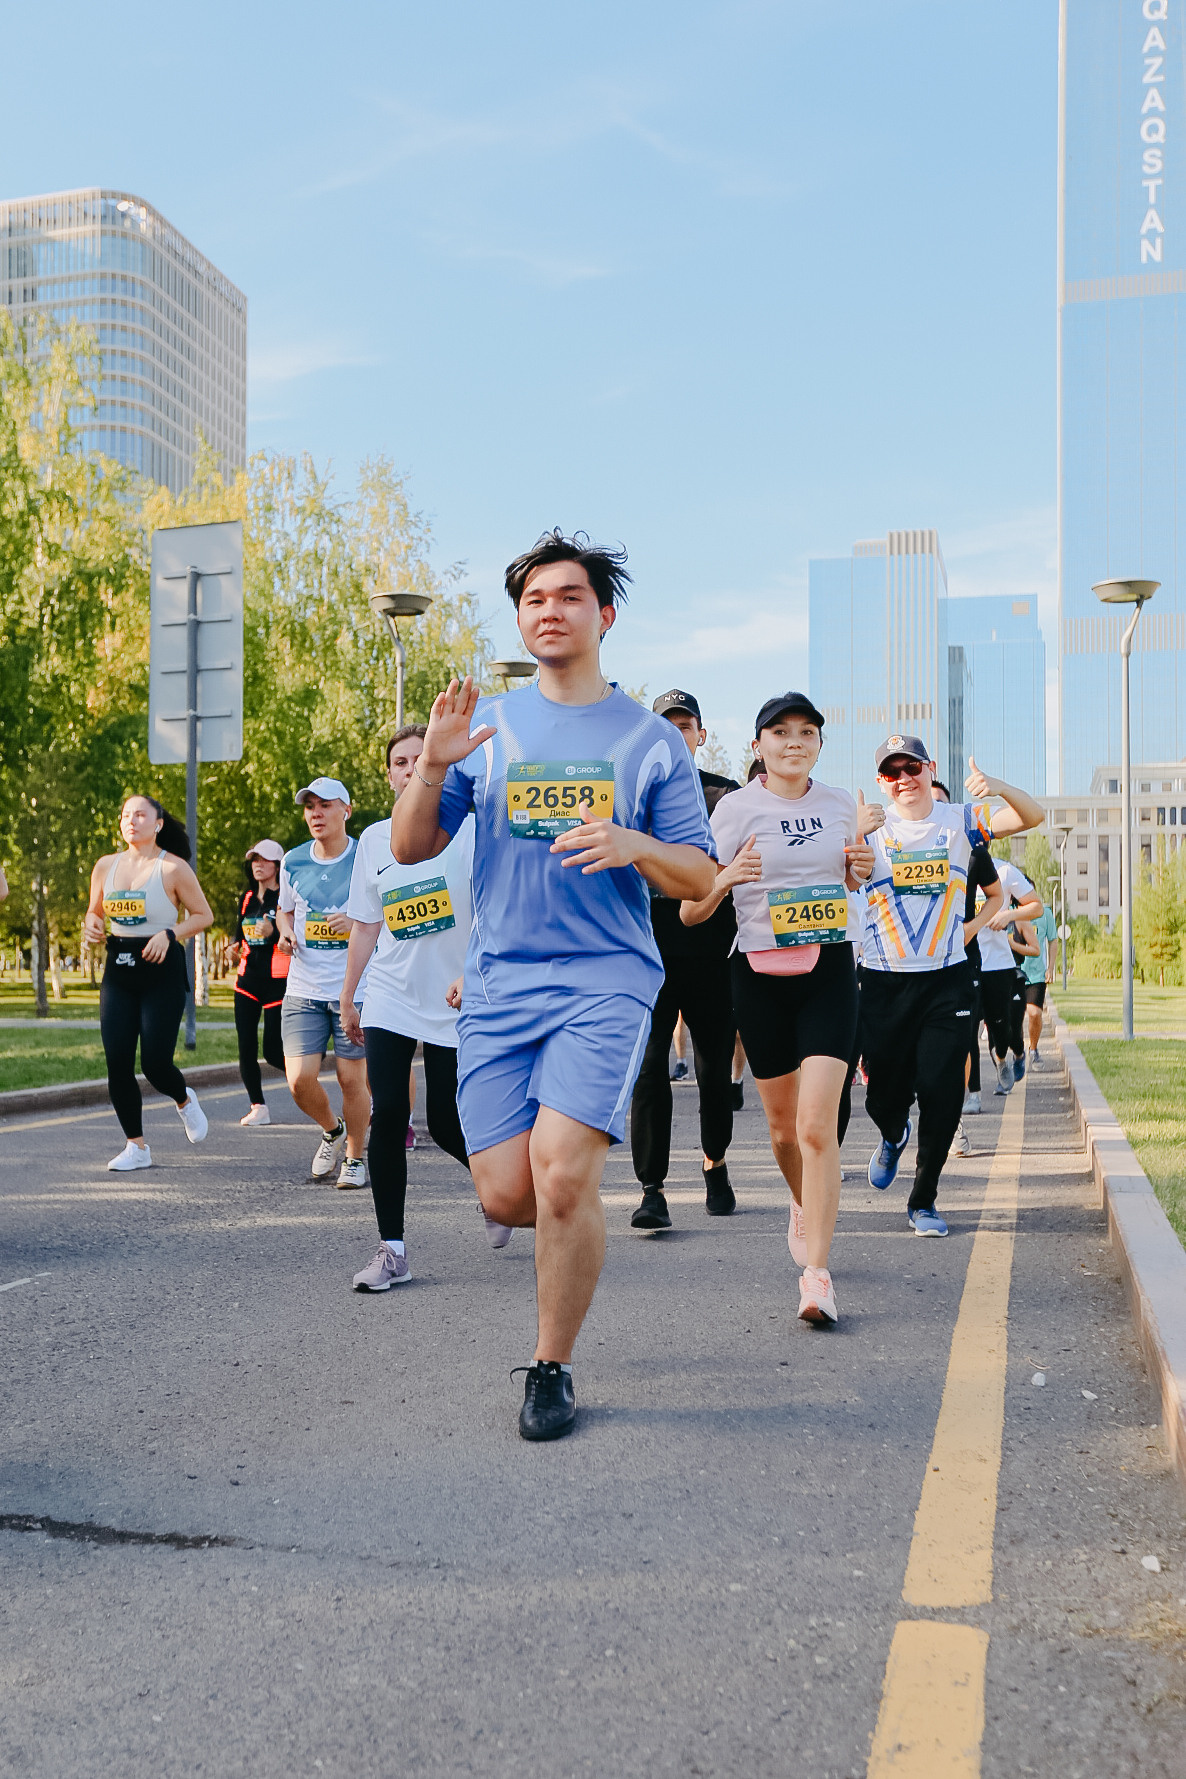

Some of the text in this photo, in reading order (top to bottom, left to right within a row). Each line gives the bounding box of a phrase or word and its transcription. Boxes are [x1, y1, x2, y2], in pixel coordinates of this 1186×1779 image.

[1140, 0, 1168, 264] QAZAQSTAN
[525, 785, 595, 809] 2658
[549, 810, 571, 818] Диас
[538, 820, 560, 828] Sulpak
[780, 817, 824, 834] RUN
[903, 863, 945, 880] 2294
[110, 901, 137, 913] 2946
[396, 898, 440, 922] 4303
[785, 902, 836, 924] 2466
[313, 924, 345, 936] 266
